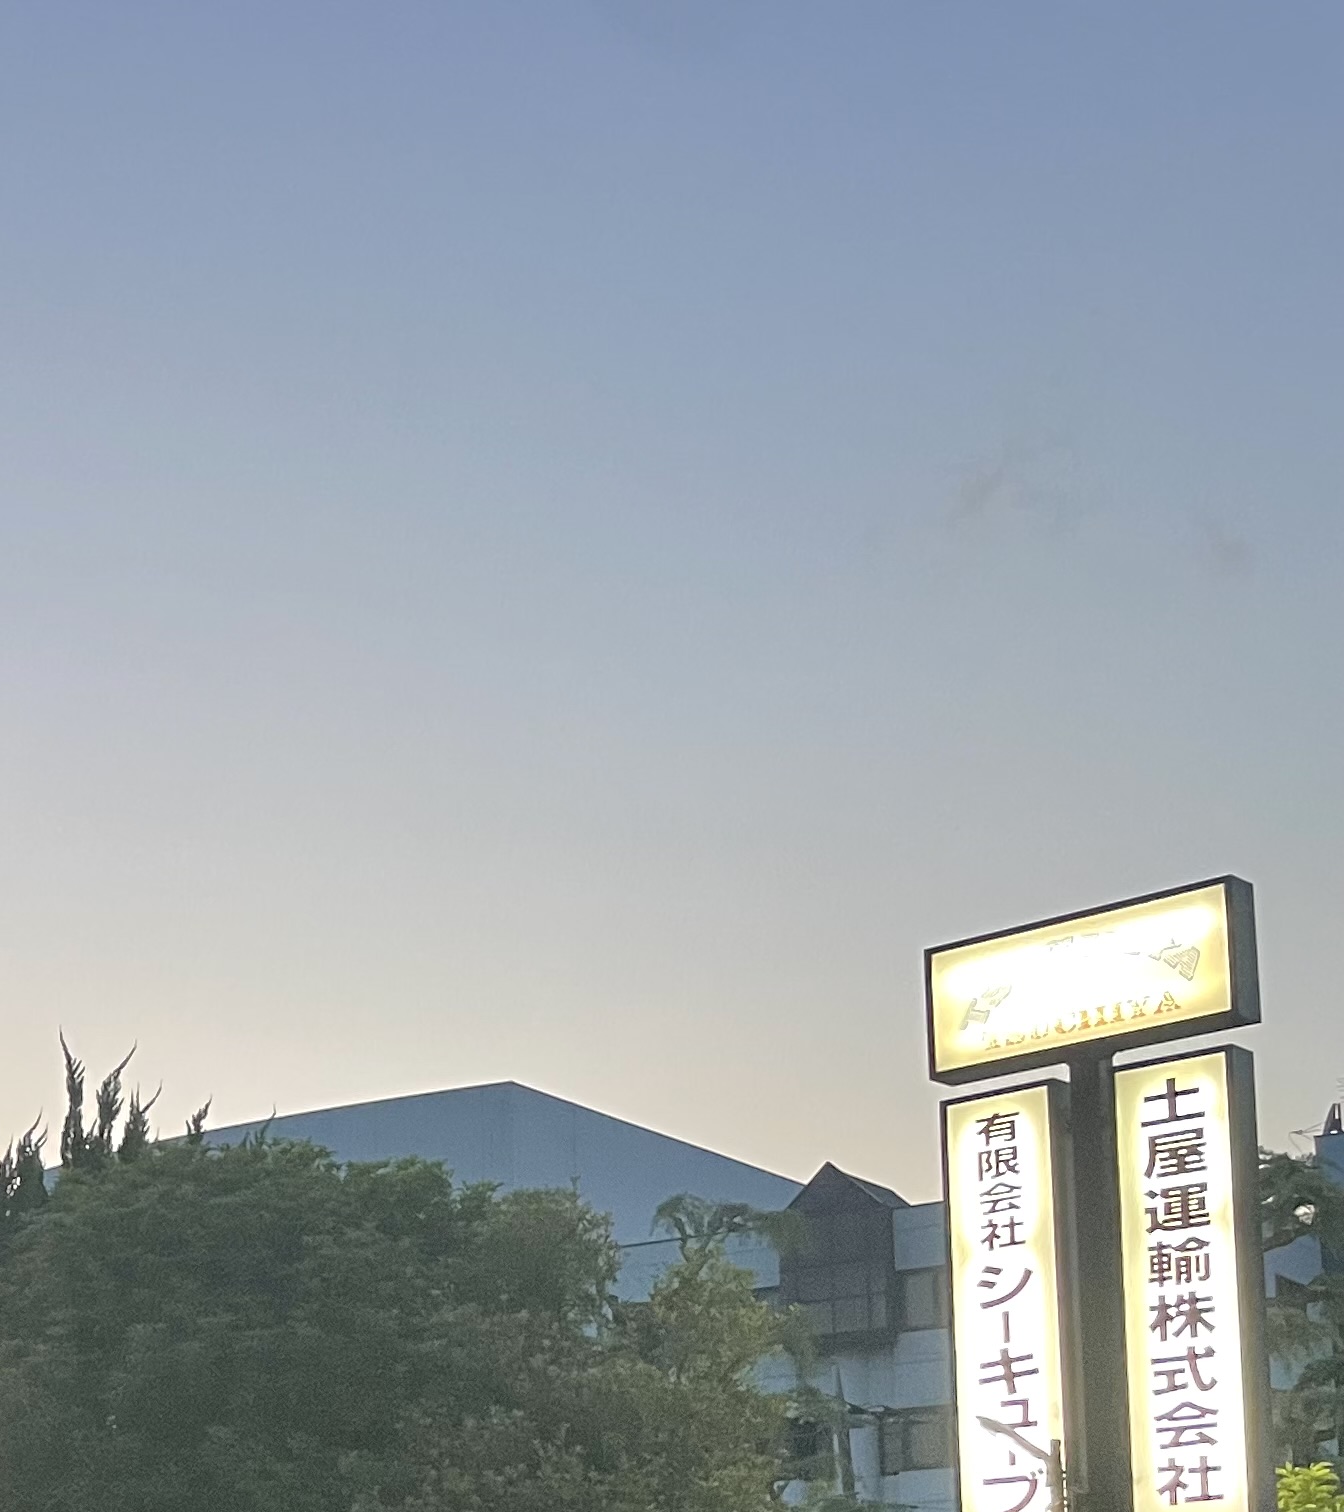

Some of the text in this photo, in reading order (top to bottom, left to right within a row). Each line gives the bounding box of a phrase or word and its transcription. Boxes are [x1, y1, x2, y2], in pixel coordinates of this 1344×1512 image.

[1140, 1077, 1224, 1508] 土屋運輸株式会社
